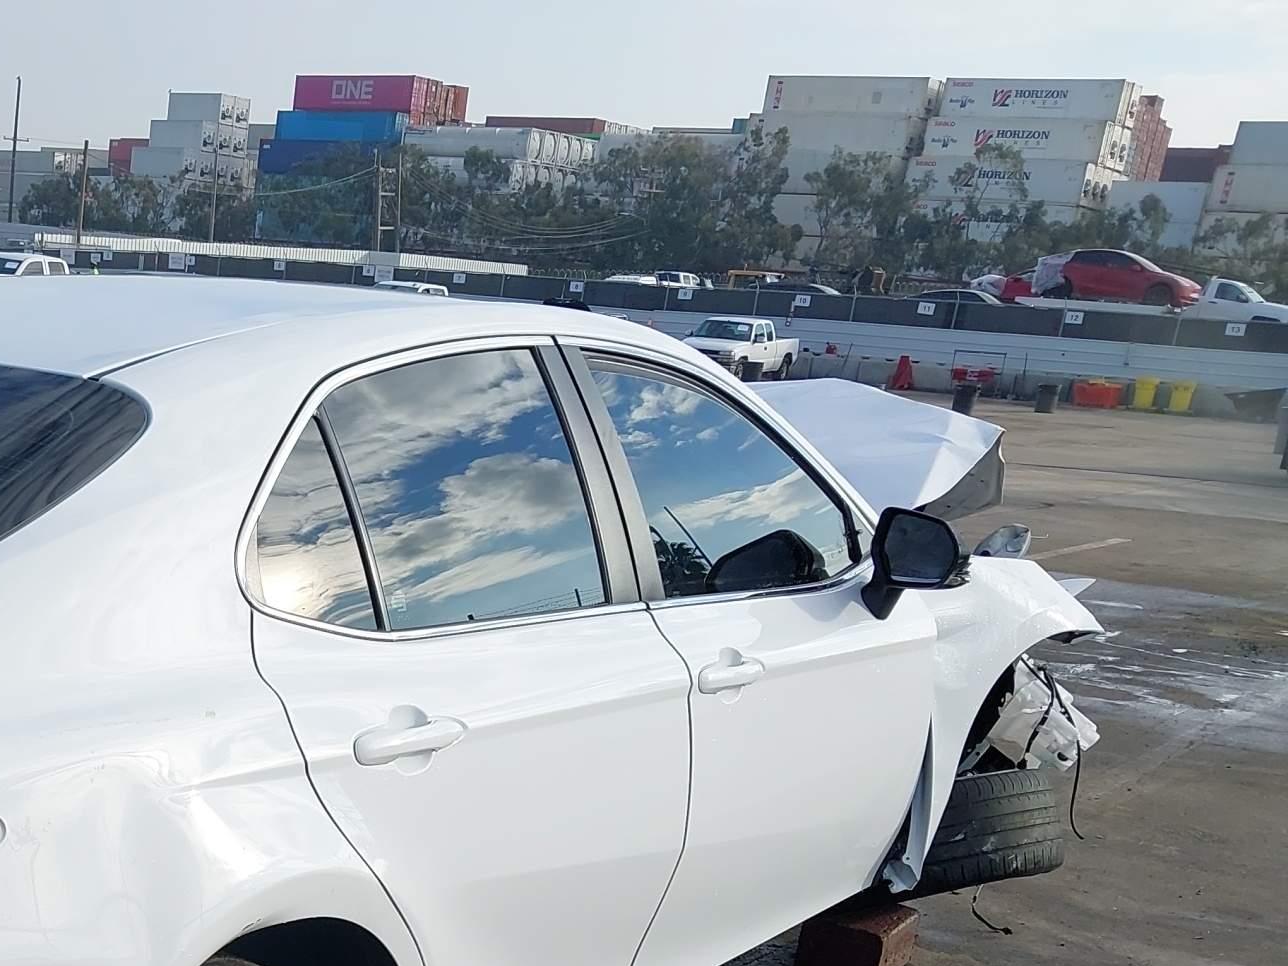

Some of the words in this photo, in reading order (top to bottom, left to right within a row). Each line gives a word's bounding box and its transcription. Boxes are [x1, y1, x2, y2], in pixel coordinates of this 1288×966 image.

[331, 79, 374, 99] ONE
[1014, 89, 1069, 99] HORIZON
[996, 129, 1050, 140] HORIZON
[977, 169, 1031, 181] HORIZON
